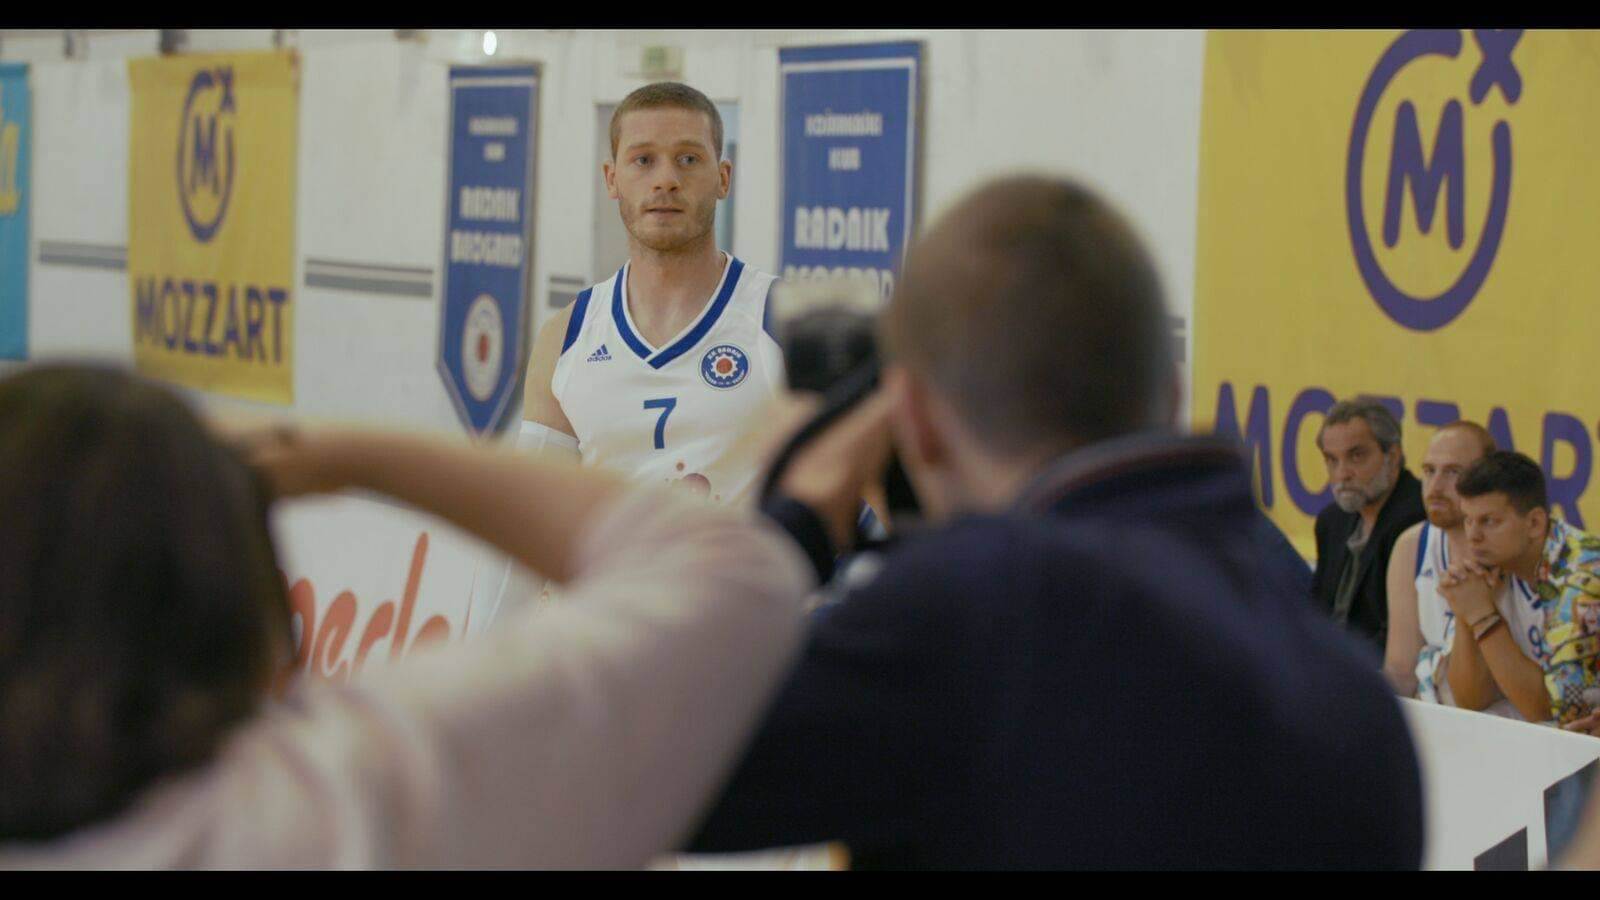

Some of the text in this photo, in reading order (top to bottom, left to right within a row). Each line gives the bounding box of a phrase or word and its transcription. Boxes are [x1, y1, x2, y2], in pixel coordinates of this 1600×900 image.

[794, 207, 891, 252] RADNIK
[136, 275, 290, 365] MOZZART
[643, 397, 678, 449] 7
